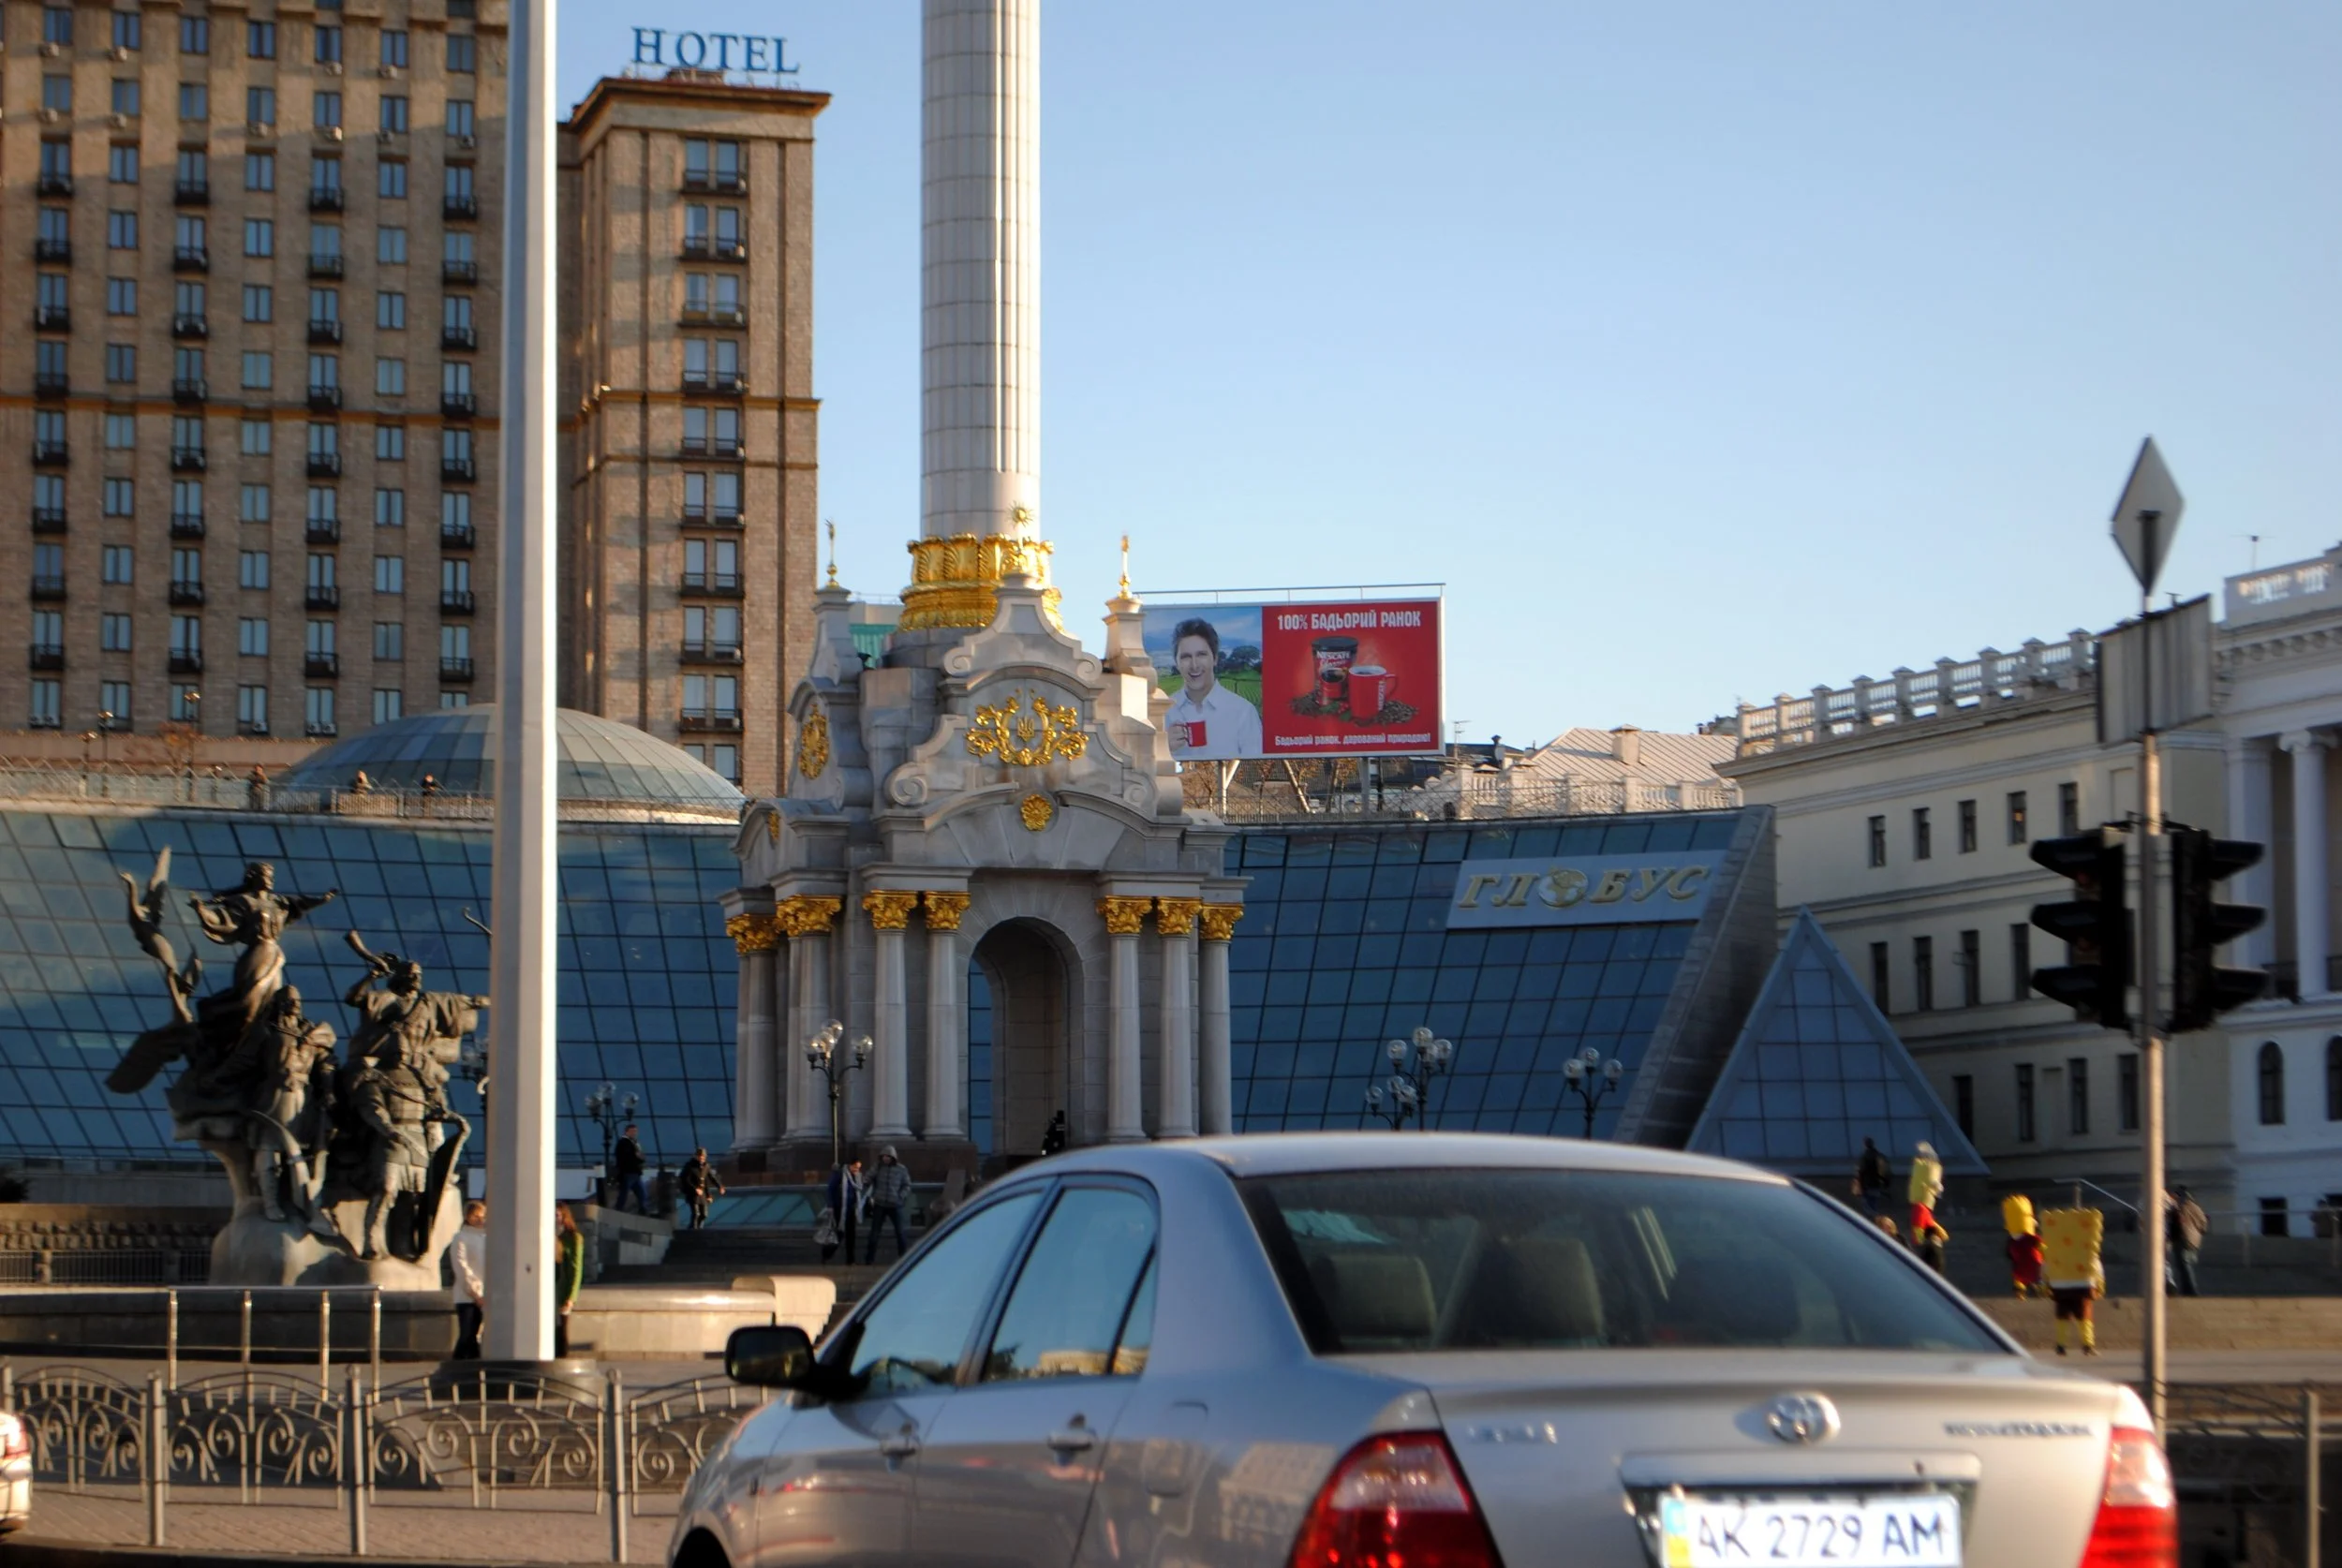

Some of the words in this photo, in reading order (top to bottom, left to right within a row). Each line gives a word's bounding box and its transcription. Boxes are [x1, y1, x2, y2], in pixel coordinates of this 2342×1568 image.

[631, 26, 800, 73] HOTEL
[1277, 614, 1308, 630] 100%
[1311, 610, 1377, 631] БАДЬОРИЙ
[1381, 611, 1421, 628] РАНОК
[1766, 1512, 1863, 1559] 2729
